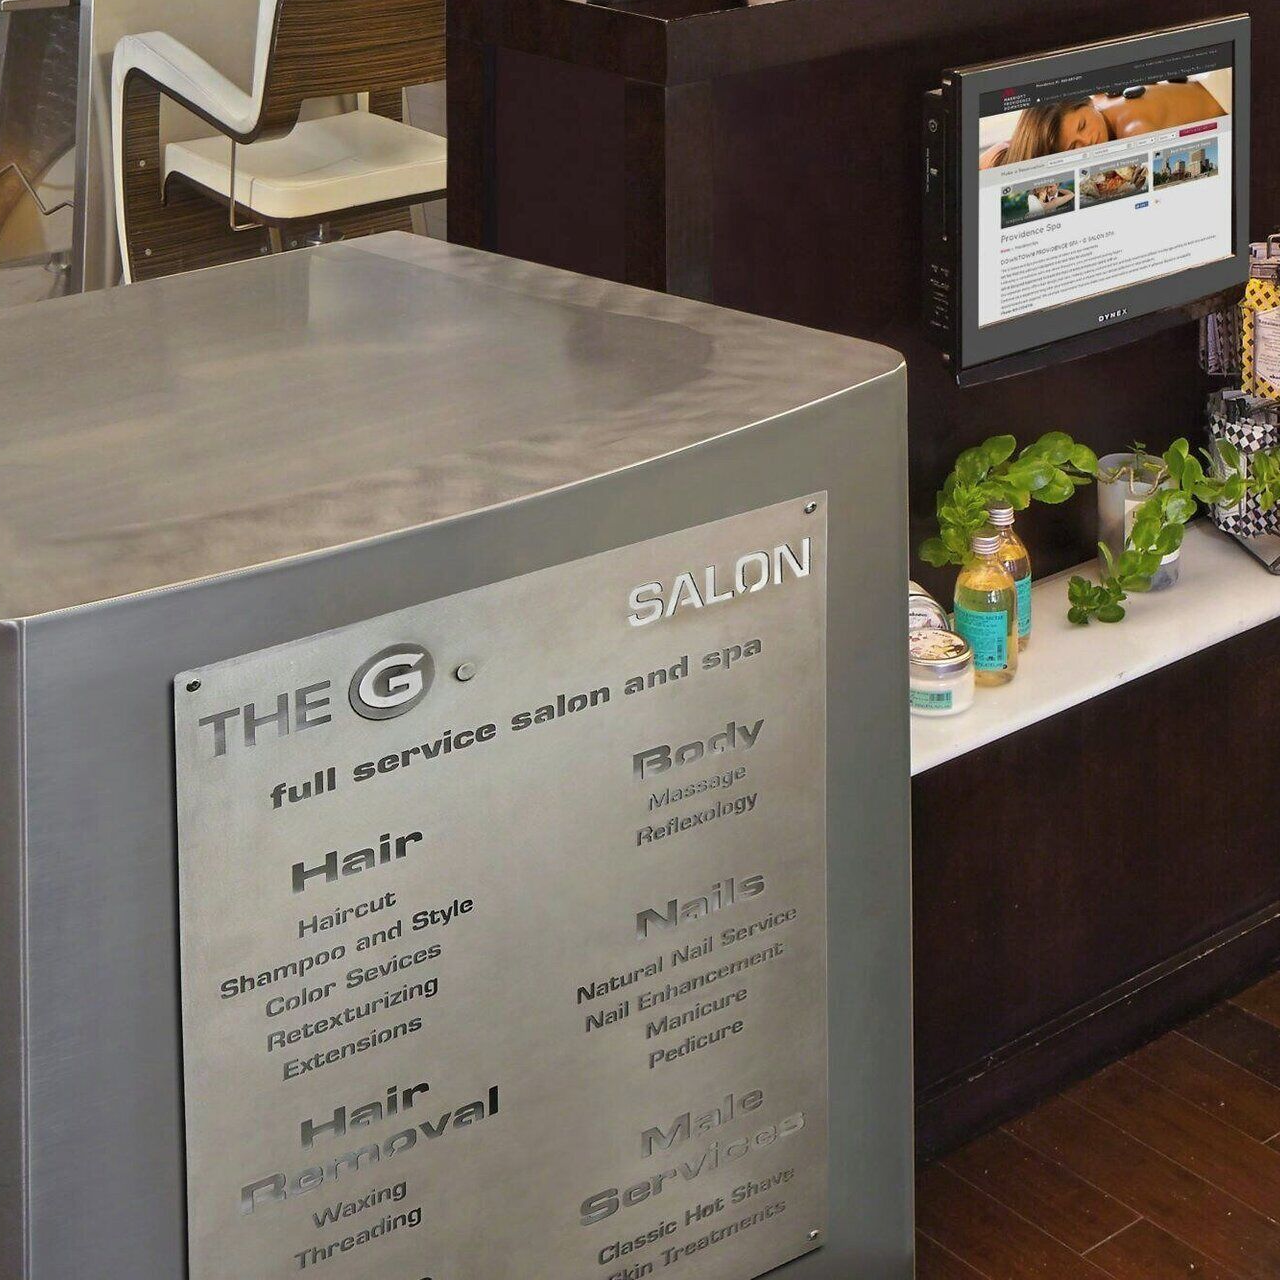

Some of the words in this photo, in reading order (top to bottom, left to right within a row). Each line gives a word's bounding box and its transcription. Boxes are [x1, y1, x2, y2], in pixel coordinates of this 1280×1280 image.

[1001, 227, 1044, 243] Providence
[1046, 223, 1061, 232] Spa
[1098, 308, 1127, 322] DYNEX
[199, 681, 331, 757] THE
[354, 649, 429, 713] G
[628, 537, 811, 627] SALON
[270, 767, 336, 809] full
[353, 723, 496, 781] service
[511, 686, 610, 731] salon
[624, 656, 688, 695] and
[702, 639, 762, 670] spa
[633, 719, 764, 780] Body
[636, 793, 757, 846] Reflexology
[649, 765, 746, 812] Massage
[292, 831, 422, 894] Hair
[298, 891, 396, 938] Haircut
[636, 874, 765, 941] Nails
[221, 944, 346, 1000] Shampoo
[356, 921, 402, 951] and
[412, 899, 473, 931] Style
[266, 982, 336, 1018] Color
[346, 943, 441, 990] Sevices
[577, 956, 663, 1005] Natural
[671, 937, 713, 965] Nail
[721, 906, 797, 946] Service
[268, 978, 438, 1052] Retexturizing
[585, 1002, 628, 1032] Nail
[638, 942, 785, 1012] Enhancement
[646, 987, 747, 1039] Manicure
[283, 1017, 422, 1081] Extensions
[649, 1020, 744, 1069] Pedicure
[301, 1082, 429, 1149] Hair
[641, 1088, 763, 1158] Male
[241, 1085, 498, 1215] Removal
[580, 1110, 806, 1226] Services
[294, 1208, 421, 1269] Threading
[312, 1182, 407, 1229] Waxing
[598, 1220, 676, 1265] Classic
[685, 1198, 725, 1225] Hot
[731, 1168, 794, 1204] Shave
[661, 1200, 786, 1266] Treatments
